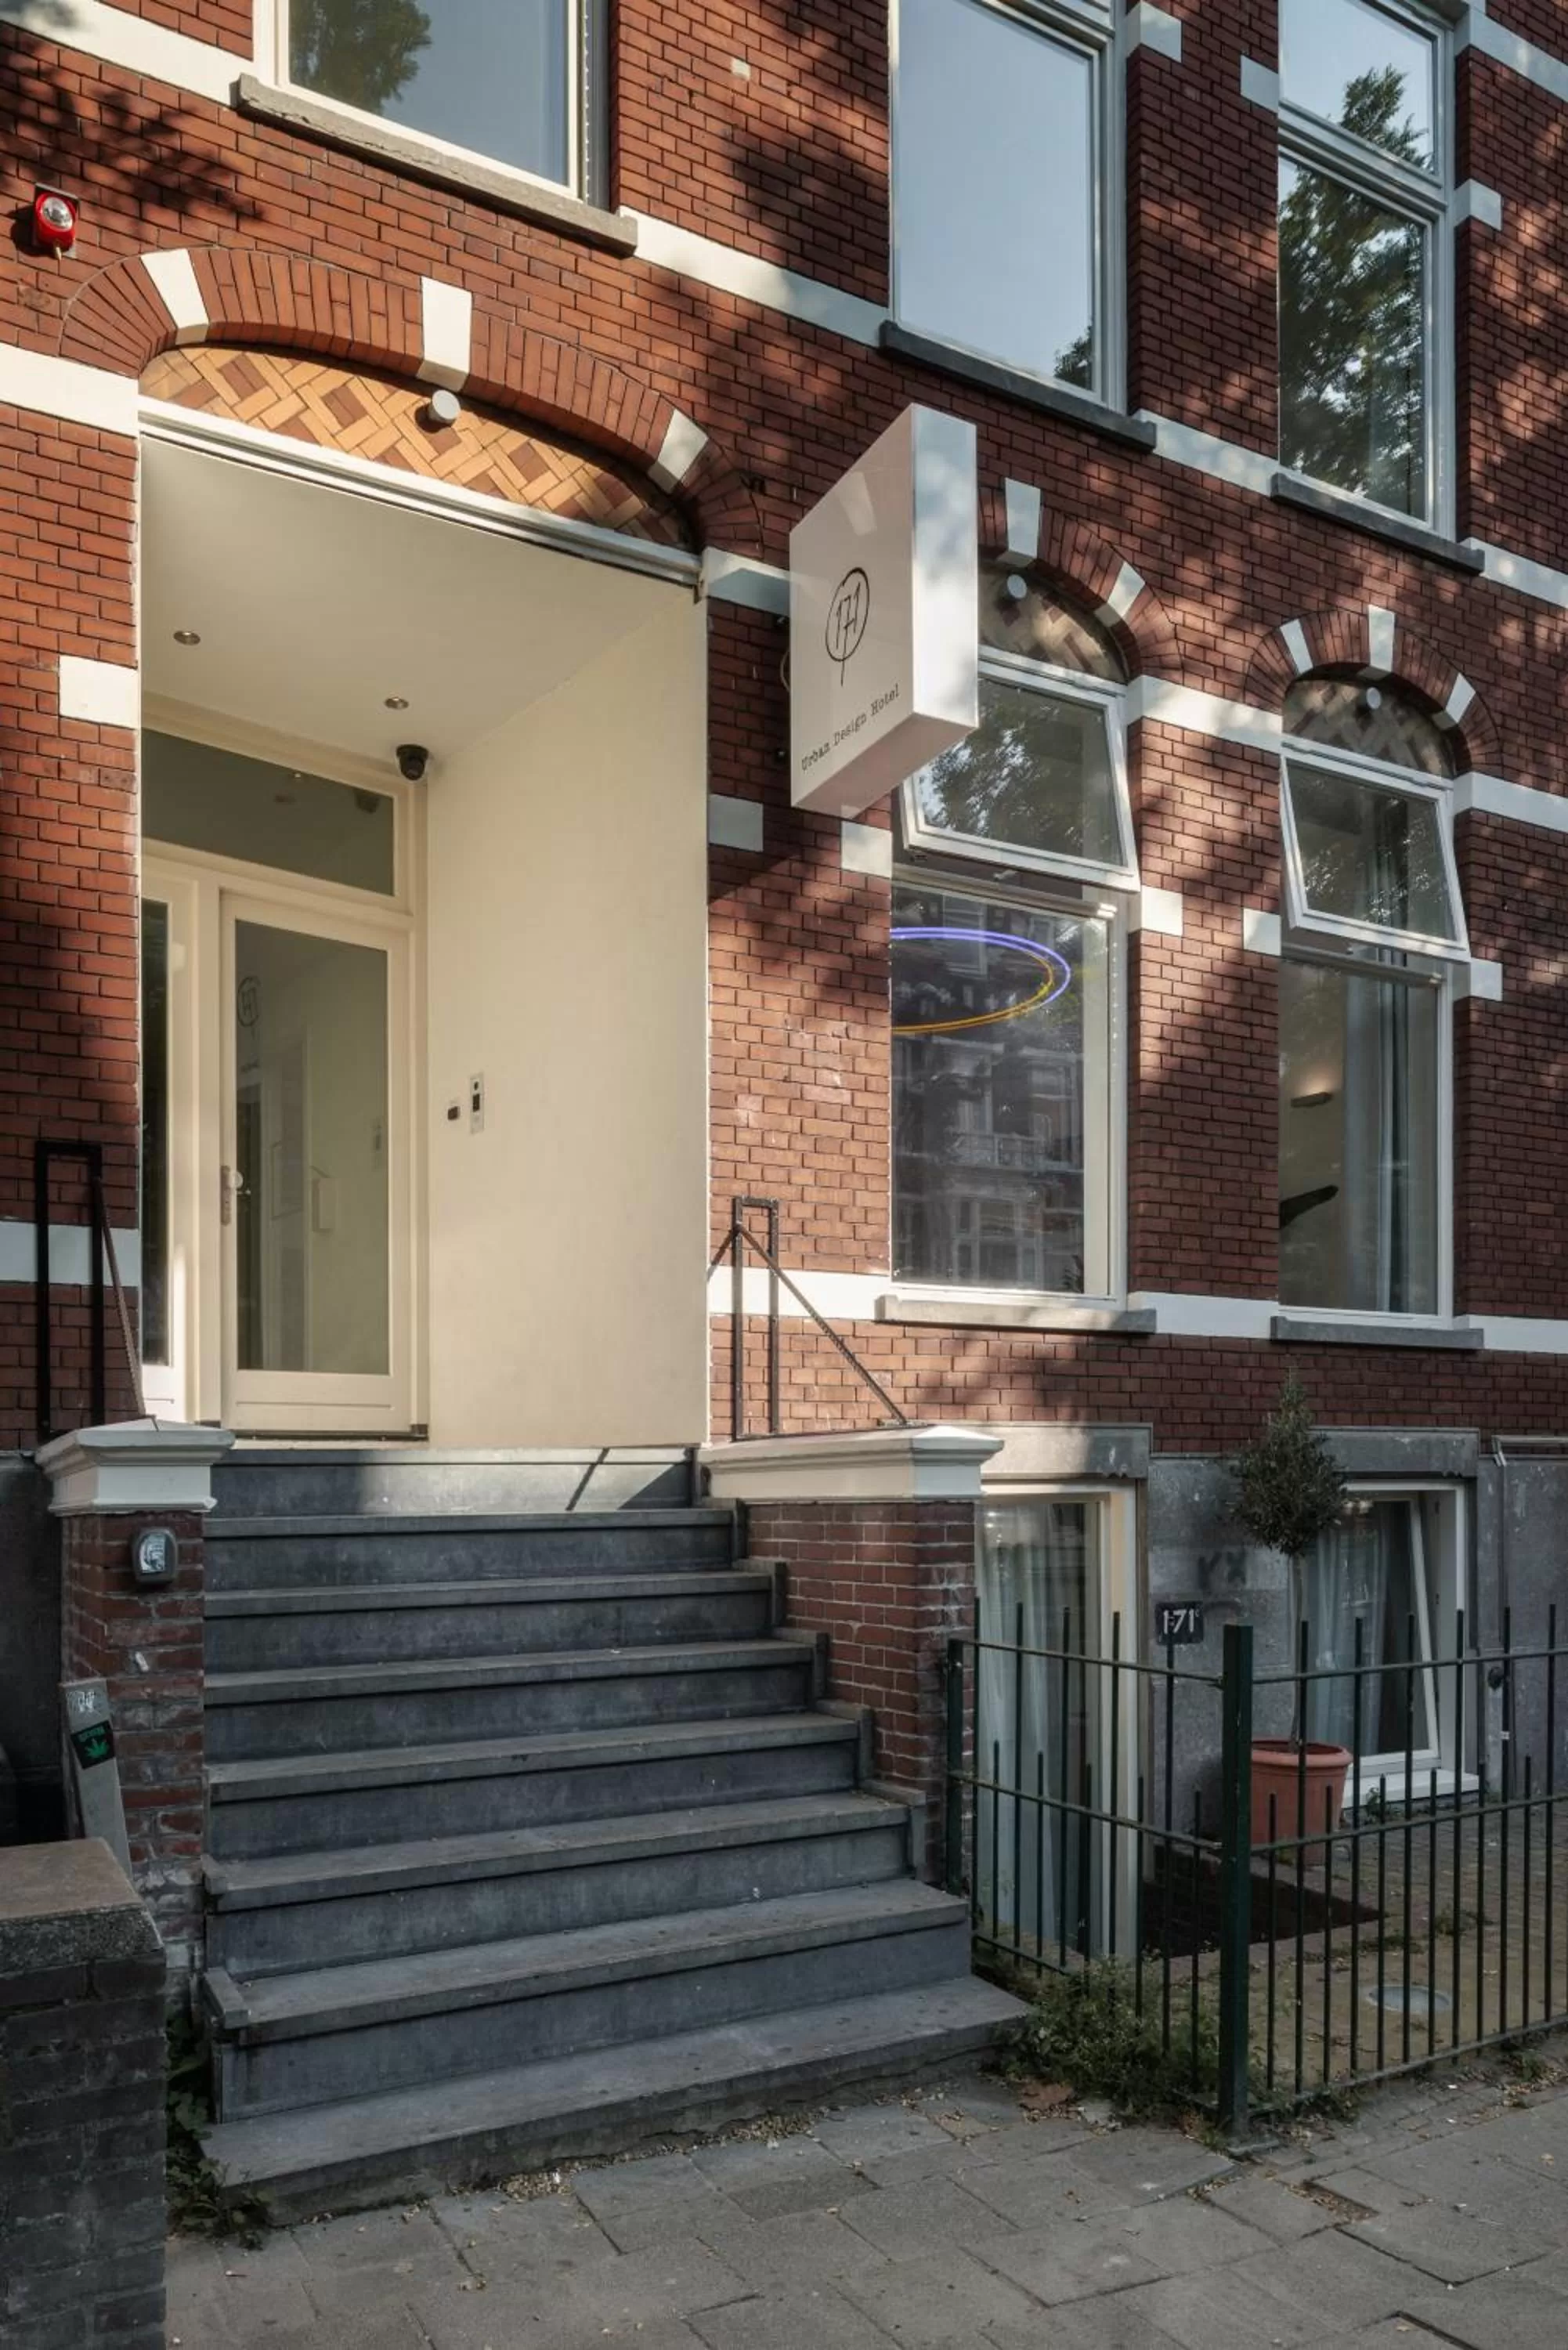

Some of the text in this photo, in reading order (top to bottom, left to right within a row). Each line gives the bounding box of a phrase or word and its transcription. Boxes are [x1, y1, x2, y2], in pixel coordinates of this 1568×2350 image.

[801, 682, 900, 770] Urban Design Hotel
